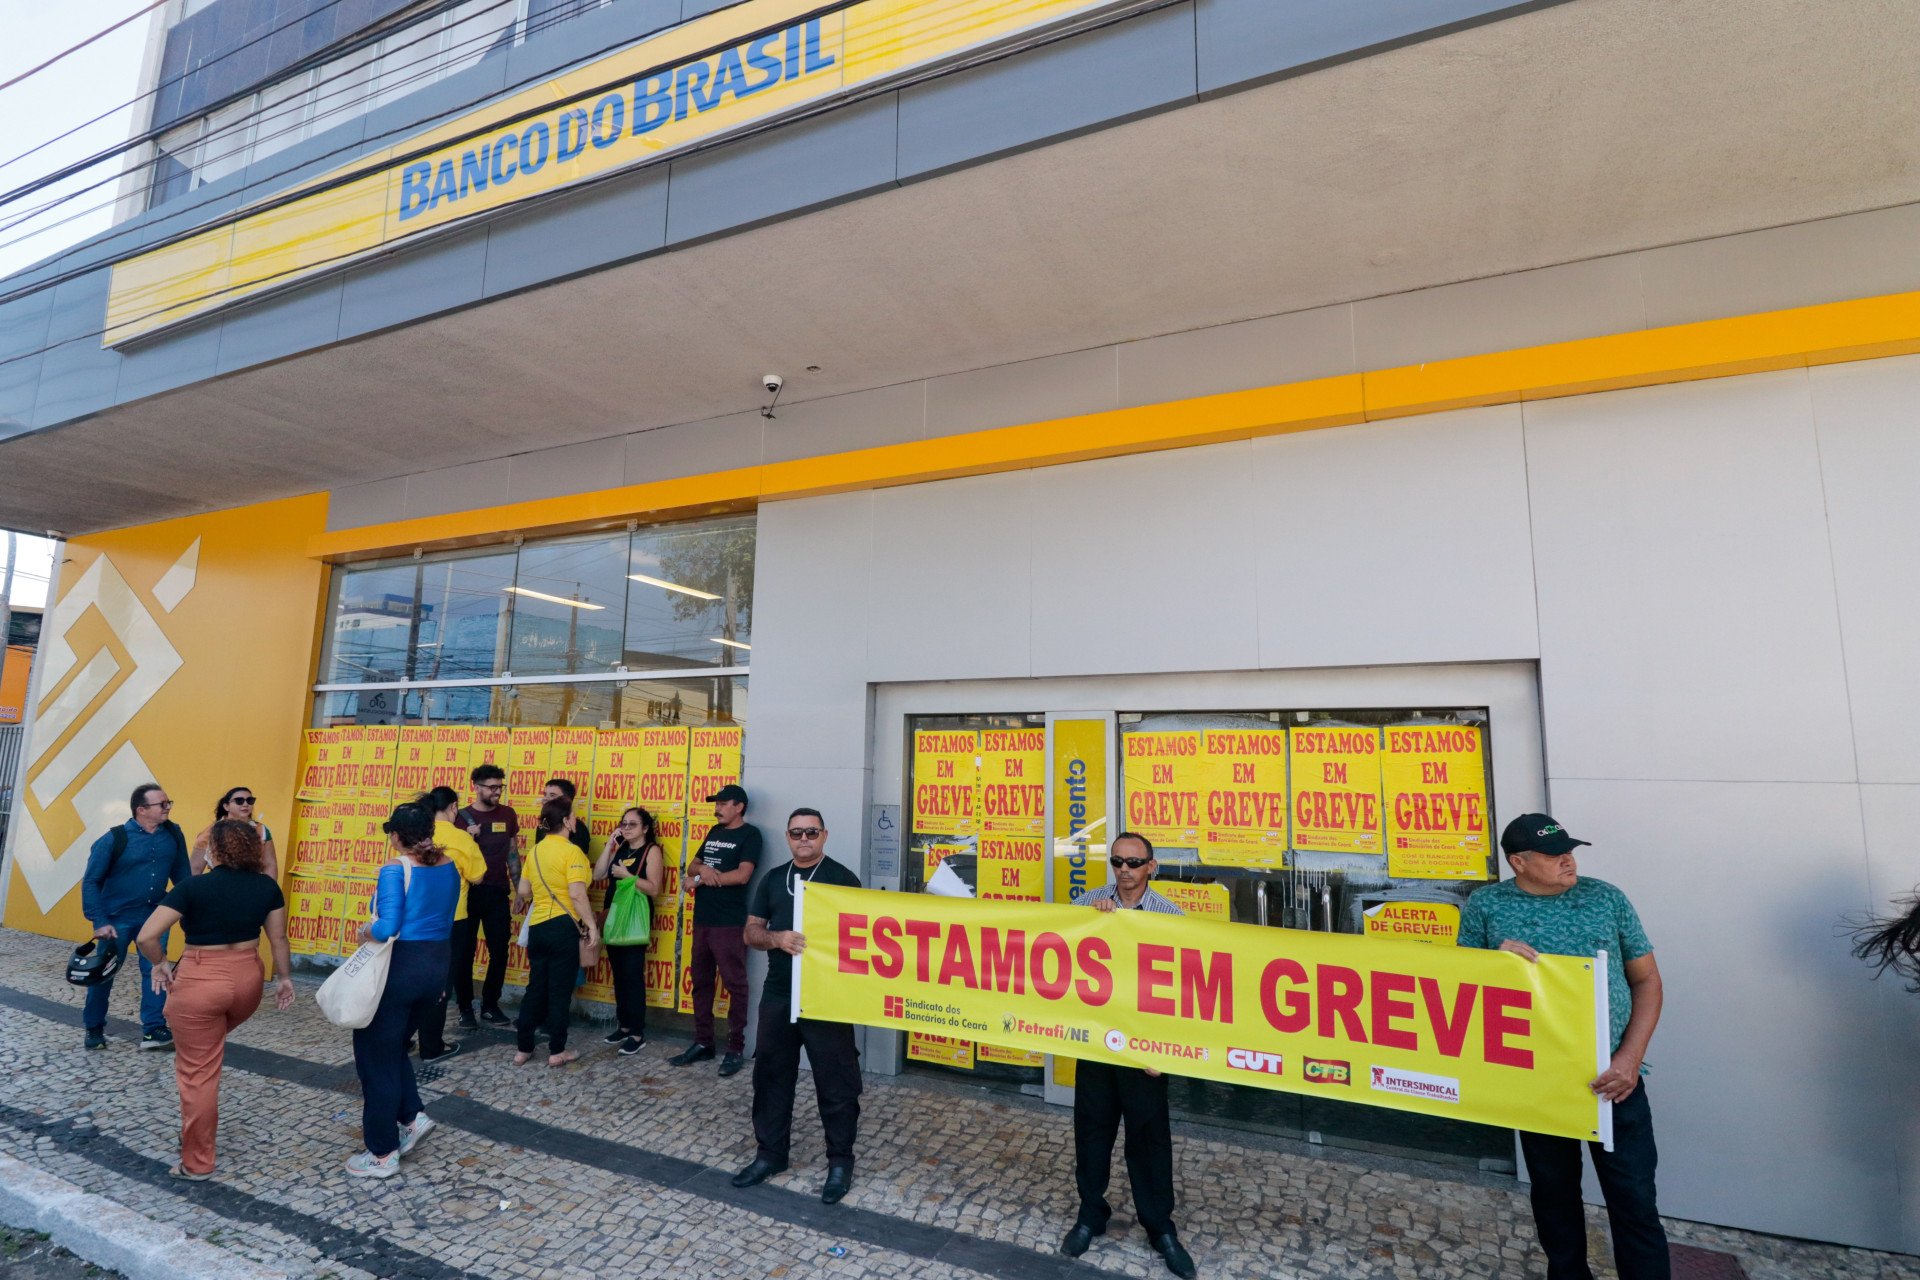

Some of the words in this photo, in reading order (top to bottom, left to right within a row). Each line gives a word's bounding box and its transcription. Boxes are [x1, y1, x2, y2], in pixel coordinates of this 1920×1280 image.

[399, 122, 550, 221] BANCO
[557, 93, 625, 164] DO
[632, 17, 836, 137] BRASIL
[341, 729, 363, 741] TAMOS
[368, 729, 398, 741] ESTAMOS
[402, 729, 433, 742] ESTAMOS
[437, 729, 471, 742] ESTAMOS
[474, 731, 509, 744] ESTAMOS
[513, 731, 550, 745] ESTAMOS
[554, 731, 594, 745] ESTAMOS
[599, 732, 640, 747] ESTAMOS
[644, 731, 687, 747] ESTAMOS
[694, 732, 739, 747] ESTAMOS
[919, 735, 975, 753] ESTAMOS
[984, 733, 1045, 751] ESTAMOS
[1207, 734, 1281, 755] ESTAMOS
[1295, 733, 1375, 754] ESTAMOS
[1390, 730, 1477, 753] ESTAMOS
[342, 747, 352, 759] EM
[375, 747, 385, 759] EM
[410, 748, 420, 761] EM
[446, 748, 457, 761] EM
[1127, 736, 1197, 756] ESTAMOS
[484, 750, 495, 764] EM
[524, 751, 535, 765] EM
[566, 750, 578, 765] EM
[611, 753, 624, 768] EM
[657, 753, 670, 768] EM
[708, 754, 722, 769] EM
[305, 766, 335, 788] GREVE
[335, 764, 360, 785] REVE
[362, 764, 393, 787] GREVE
[397, 766, 429, 789] GREVE
[937, 760, 954, 778] EM
[1005, 758, 1023, 778] EM
[1152, 764, 1173, 784] EM
[1233, 762, 1255, 784] EM
[1323, 762, 1347, 784] EM
[1421, 762, 1448, 784] EM
[594, 774, 636, 800] GREVE
[640, 774, 684, 801] GREVE
[332, 803, 356, 816] TAMOS
[917, 784, 974, 816] GREVE
[984, 784, 1045, 816] GREVE
[1130, 791, 1200, 826] GREVE
[1207, 790, 1283, 828] GREVE
[1296, 790, 1378, 830] GREVE
[358, 804, 389, 818] ESTAMOS
[1395, 792, 1483, 831] GREVE
[366, 822, 376, 835] EM
[655, 821, 682, 838] AMOS
[327, 839, 352, 862] REVE
[353, 840, 384, 865] GREVE
[980, 840, 1042, 861] ESTAMOS
[1001, 866, 1020, 887] EM
[322, 880, 346, 894] TAMOS
[349, 881, 376, 897] ESTAMO
[1166, 888, 1211, 900] ALERTA
[357, 902, 367, 916] EM
[1384, 908, 1438, 921] ALERTA
[317, 915, 341, 941] REVE
[1371, 920, 1388, 932] DE
[1393, 922, 1453, 936] GREVE!!!
[646, 960, 672, 989] EVE
[838, 912, 1113, 1007] ESTAMOS
[1137, 943, 1234, 1024] EM
[1260, 958, 1534, 1070] GREVE
[905, 999, 943, 1013] Sindicato
[945, 1001, 961, 1015] dos
[905, 1010, 946, 1025] Bancários
[948, 1014, 960, 1027] do
[962, 1018, 988, 1032] Ceará
[1018, 1019, 1090, 1043] Fetrafi/NE
[1129, 1037, 1203, 1060] CONTRAF
[1228, 1049, 1282, 1074] CUT
[1305, 1061, 1349, 1081] CTB
[1386, 1076, 1458, 1097] INTERSINDICAL
